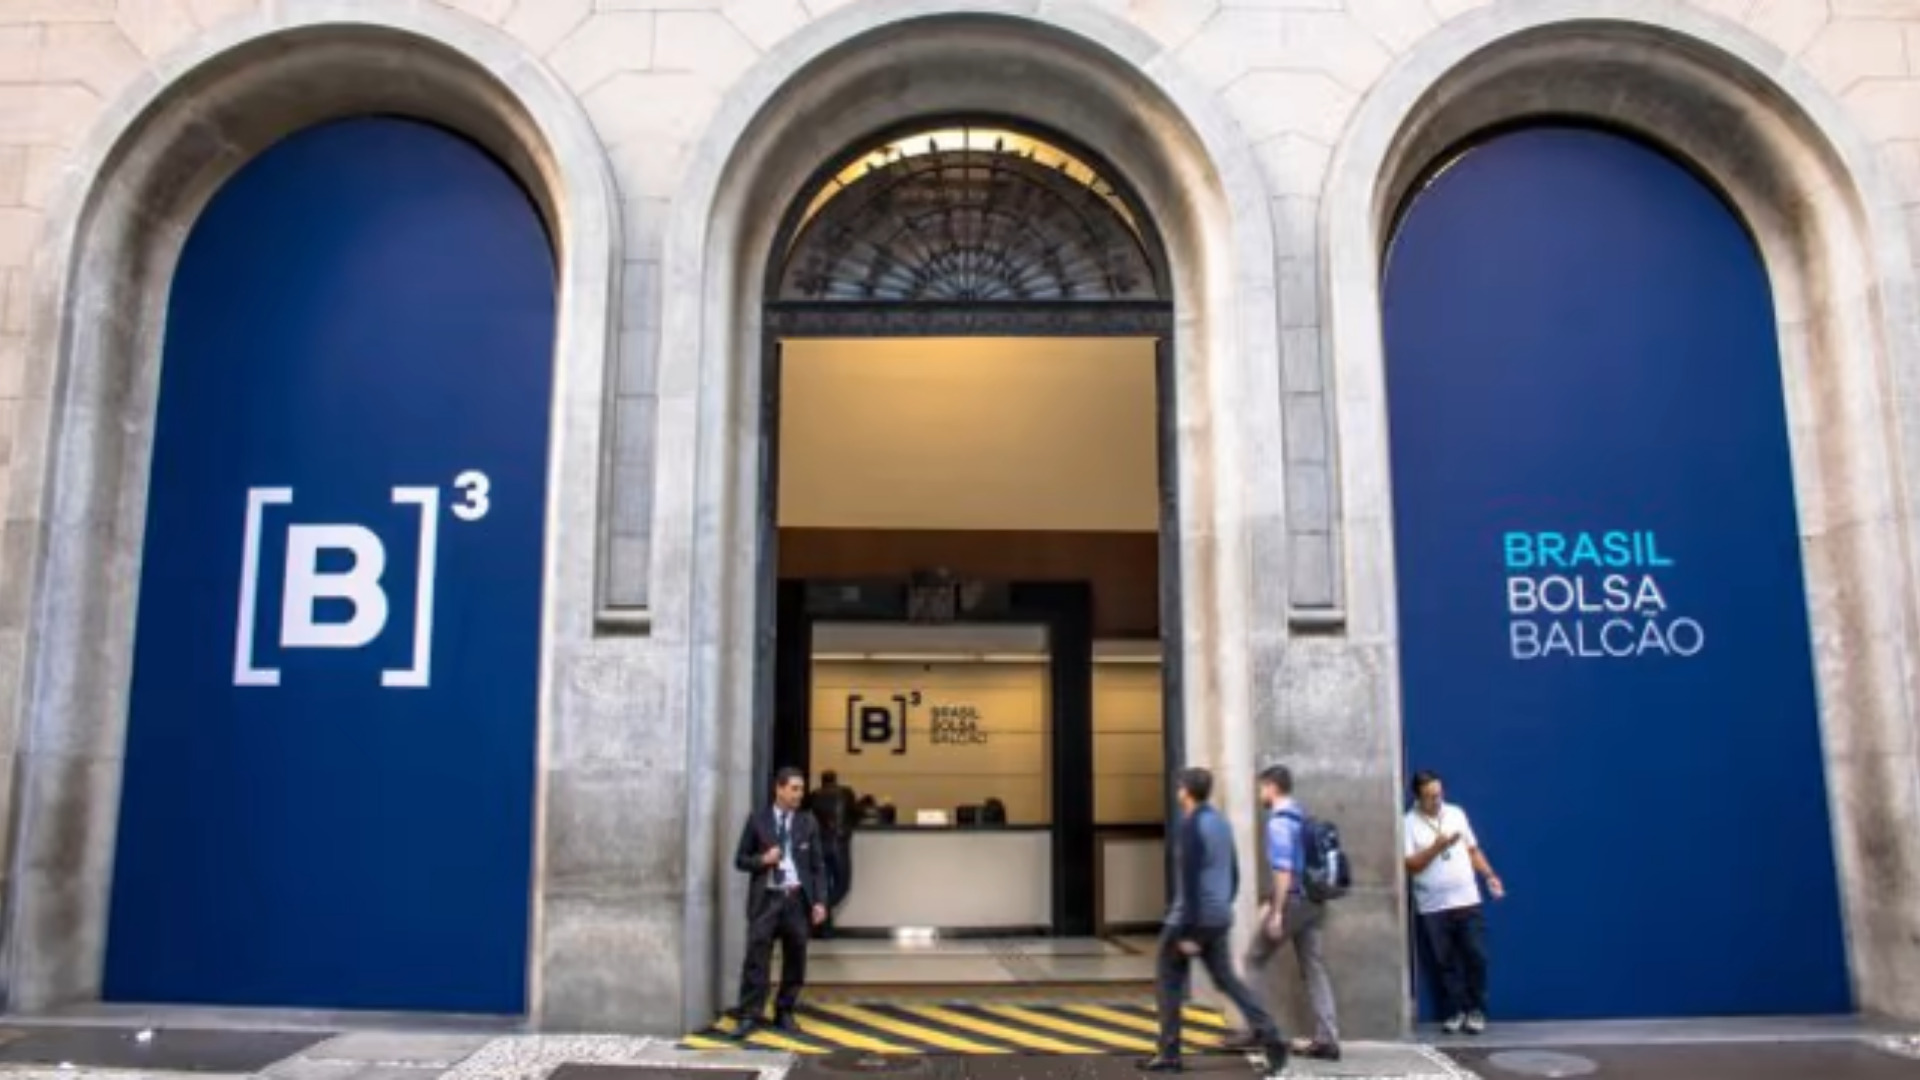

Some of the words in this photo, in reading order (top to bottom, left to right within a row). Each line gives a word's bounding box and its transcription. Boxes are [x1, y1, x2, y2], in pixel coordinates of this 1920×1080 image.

[1504, 530, 1674, 568] BRASIL
[1507, 574, 1667, 614] BOLSA
[1510, 609, 1704, 659] BALCÃO
